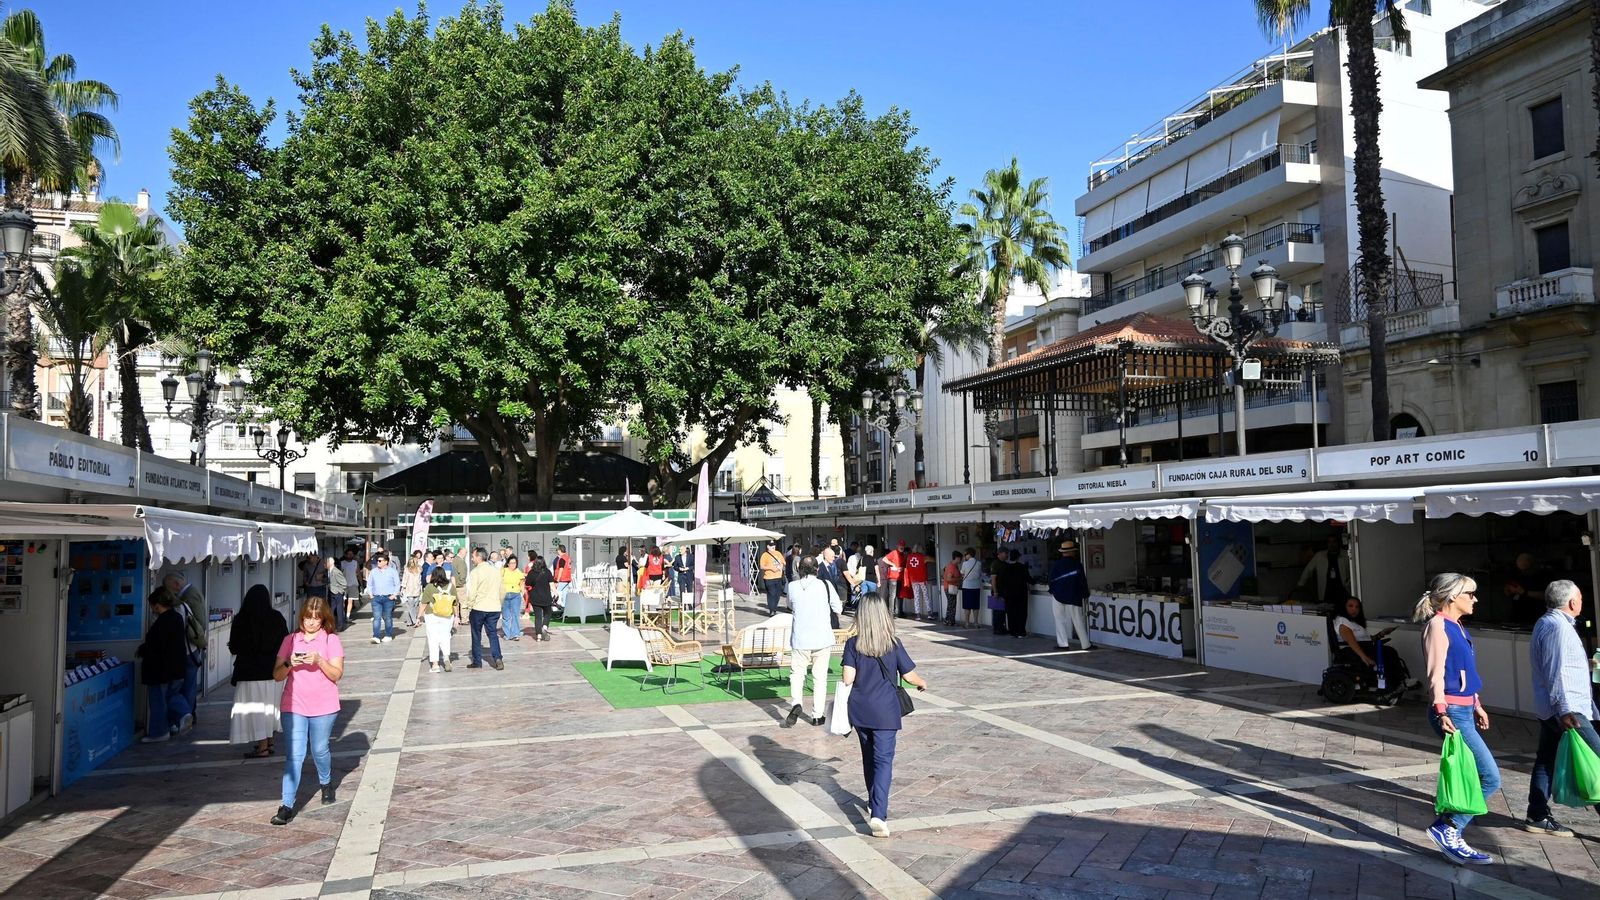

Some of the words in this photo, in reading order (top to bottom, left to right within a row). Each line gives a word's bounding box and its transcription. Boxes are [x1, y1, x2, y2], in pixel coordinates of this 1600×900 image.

[1370, 455, 1391, 467] POP
[1395, 453, 1420, 465] ART
[1425, 449, 1466, 462] COMIC
[1523, 450, 1539, 462] 10
[78, 457, 111, 476] EDITORIAL
[1208, 470, 1227, 479] CAJA
[1229, 468, 1256, 478] RURAL
[1259, 466, 1274, 475] DEL
[1276, 464, 1293, 474] SUR
[1301, 469, 1307, 478] 9
[128, 476, 135, 489] 22
[1077, 480, 1105, 491] EDITORIAL
[1106, 479, 1127, 488] NIEBLA
[1151, 480, 1156, 488] 8
